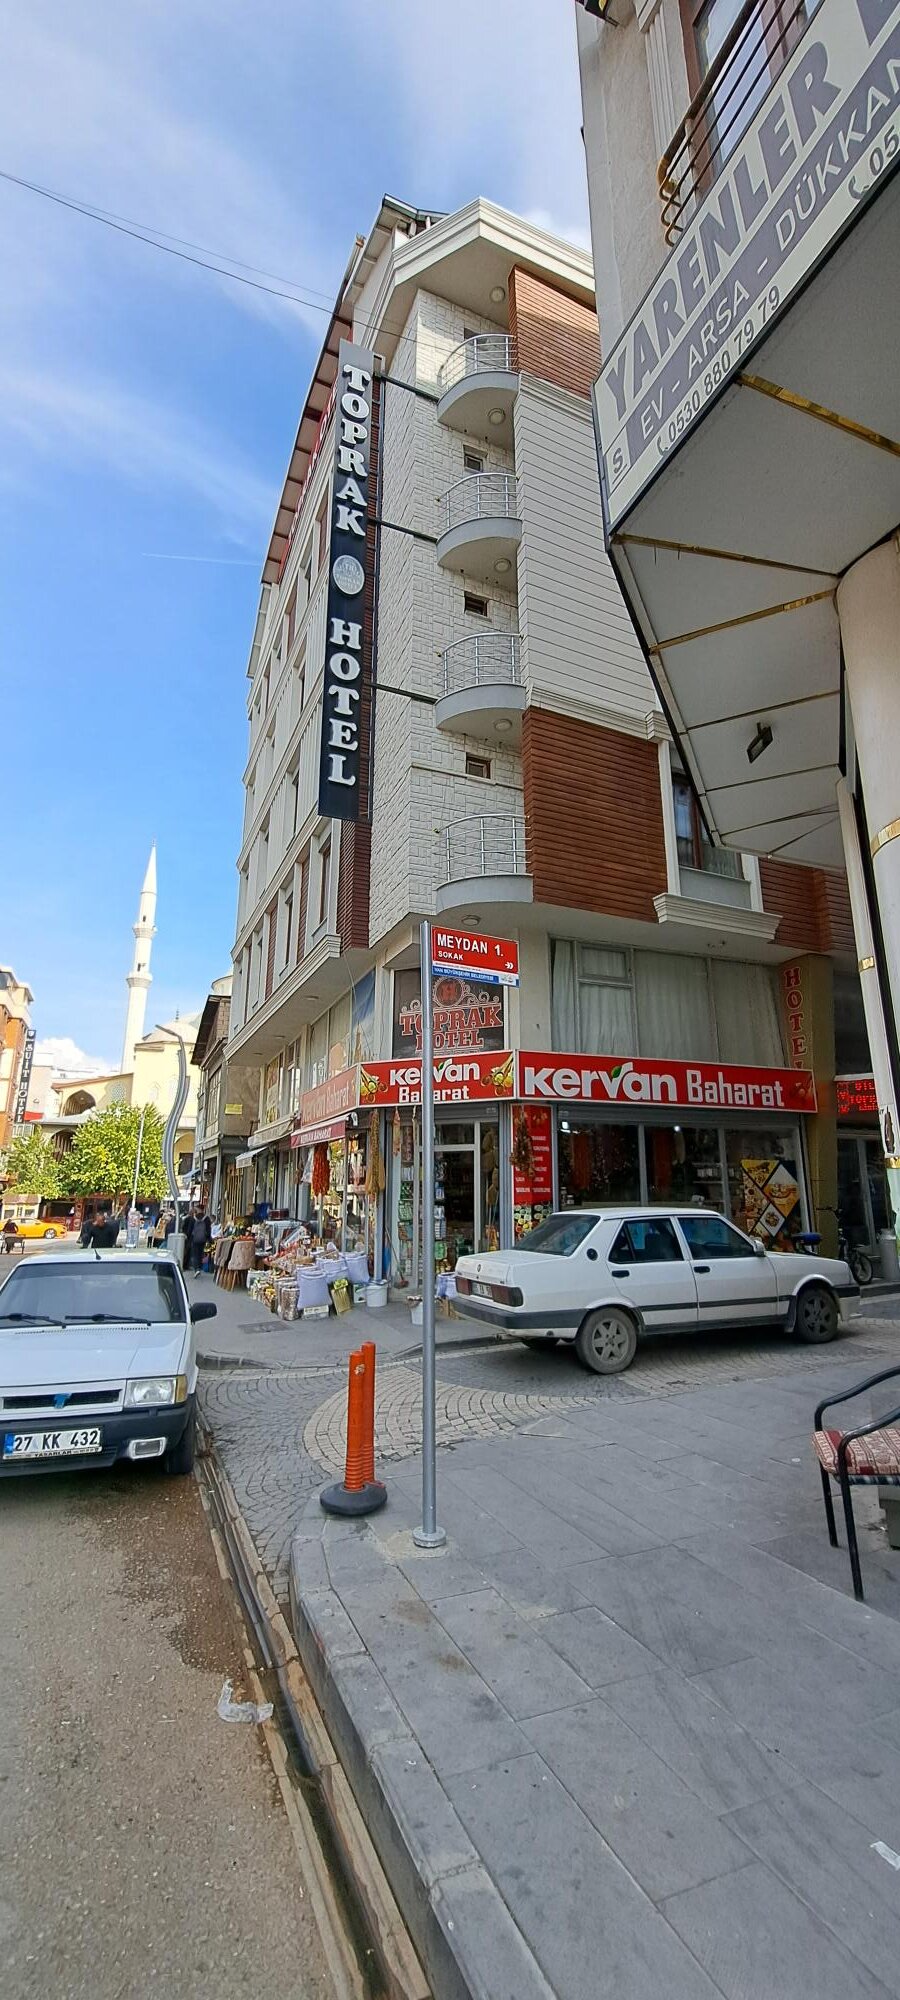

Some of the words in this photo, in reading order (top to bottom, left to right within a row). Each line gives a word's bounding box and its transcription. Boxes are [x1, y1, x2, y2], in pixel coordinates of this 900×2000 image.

[605, 41, 842, 421] YARENLER
[640, 387, 665, 440] EV
[688, 280, 750, 380] ARSA
[668, 391, 702, 443] 0530
[703, 350, 731, 396] 880
[733, 319, 756, 355] 79
[758, 285, 780, 323] 79
[335, 363, 372, 537] TOPRAK
[327, 617, 364, 788] HOTEL
[437, 933, 488, 954] MEYDAN
[494, 944, 504, 957] 1.
[437, 950, 464, 961] SOKAK
[389, 1059, 480, 1086] Kevan
[398, 1085, 470, 1103] Baarat
[524, 1061, 678, 1101] Kervan
[686, 1069, 785, 1107] Baharat
[15, 1436, 33, 1452] 27
[42, 1433, 61, 1450] KK
[70, 1430, 98, 1447] 432
